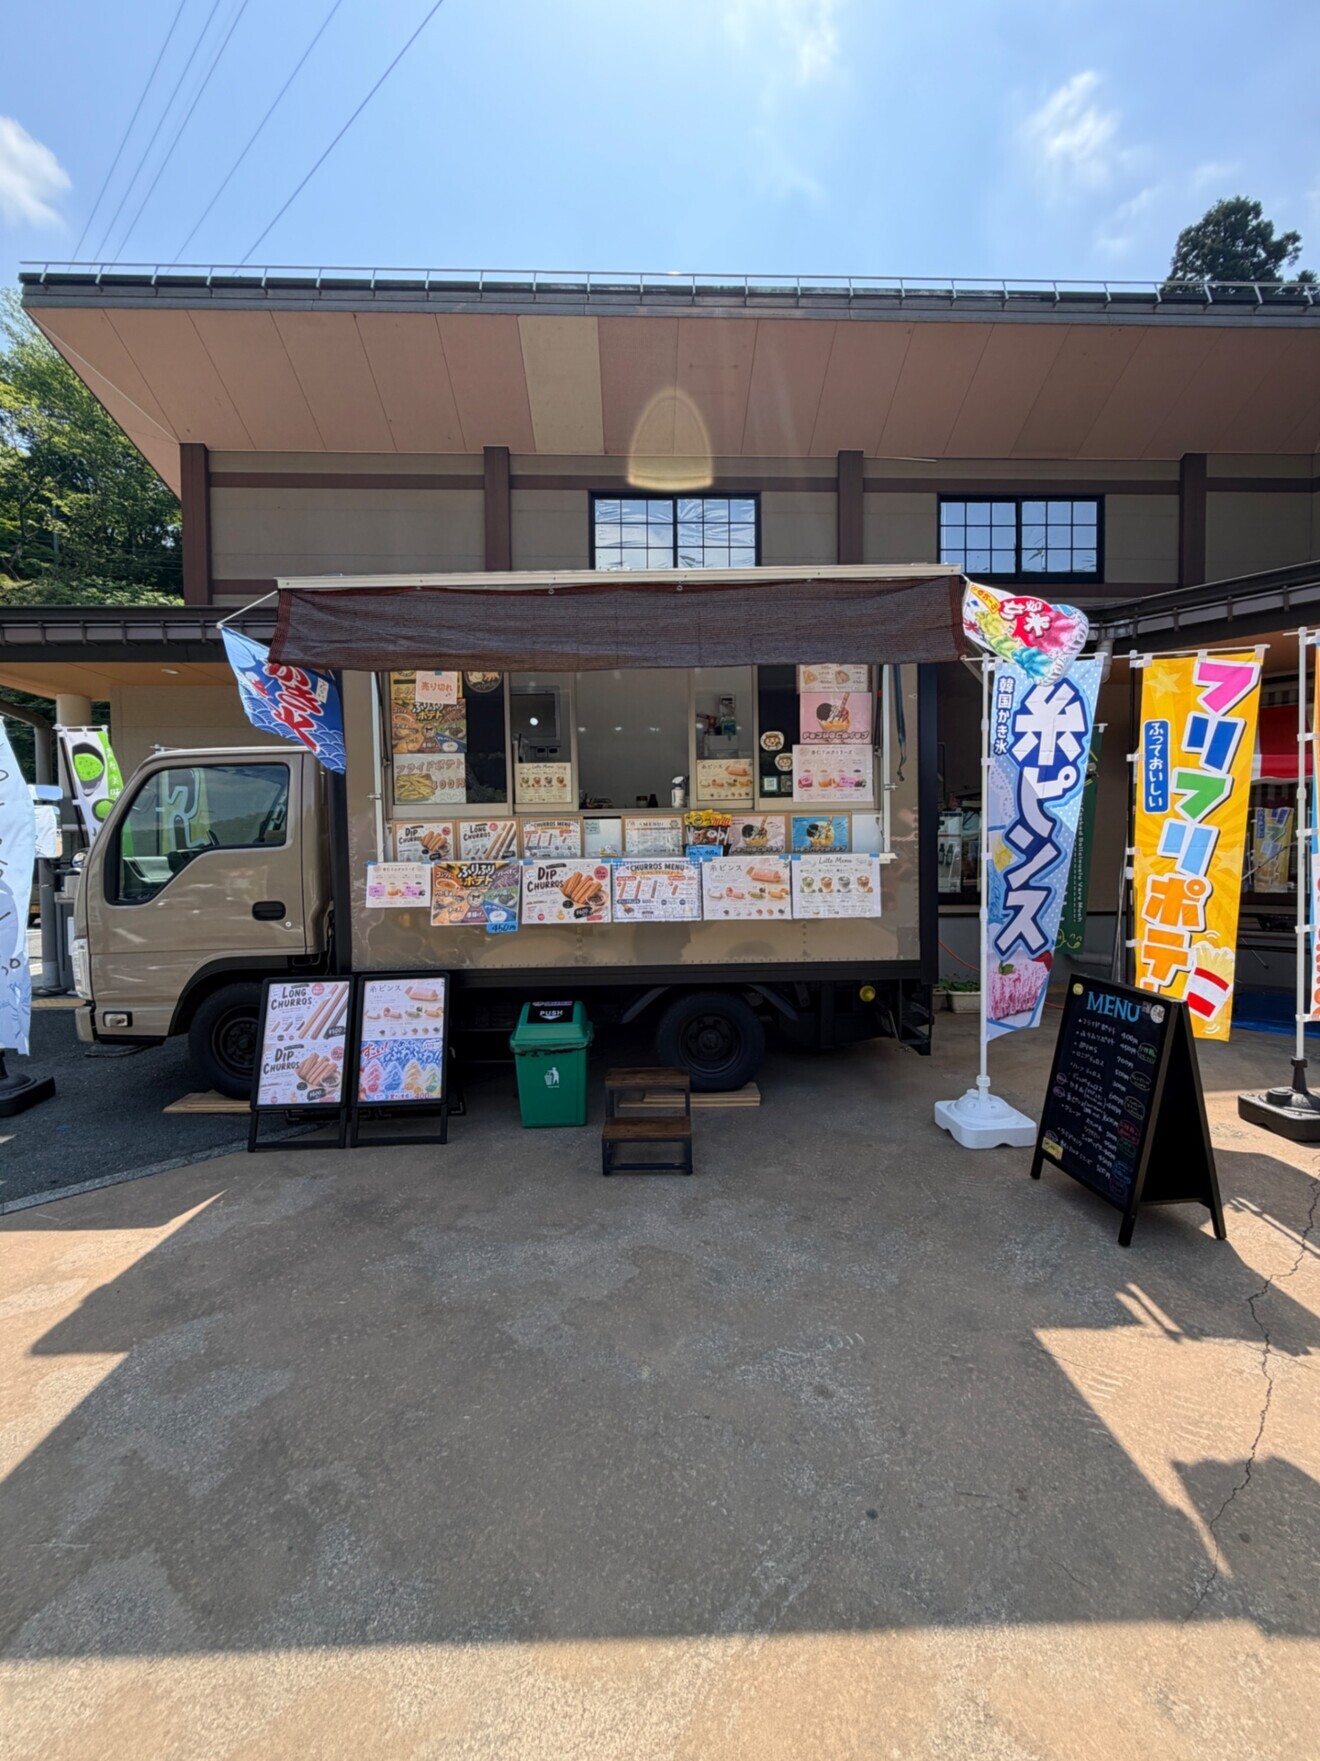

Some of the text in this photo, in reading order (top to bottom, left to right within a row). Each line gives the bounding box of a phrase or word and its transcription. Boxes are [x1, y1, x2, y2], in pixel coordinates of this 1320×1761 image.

[421, 681, 453, 692] 売り切れ
[993, 674, 1016, 756] 韓国かき氷
[1148, 721, 1165, 808] ふっておいしい
[996, 681, 1085, 953] 糸ピンス
[1139, 658, 1260, 991] フリフリポテ
[458, 864, 495, 877] ふりふり
[463, 875, 493, 886] ポテト
[630, 863, 685, 872] CHURROS MENU
[1086, 990, 1142, 1022] MENU
